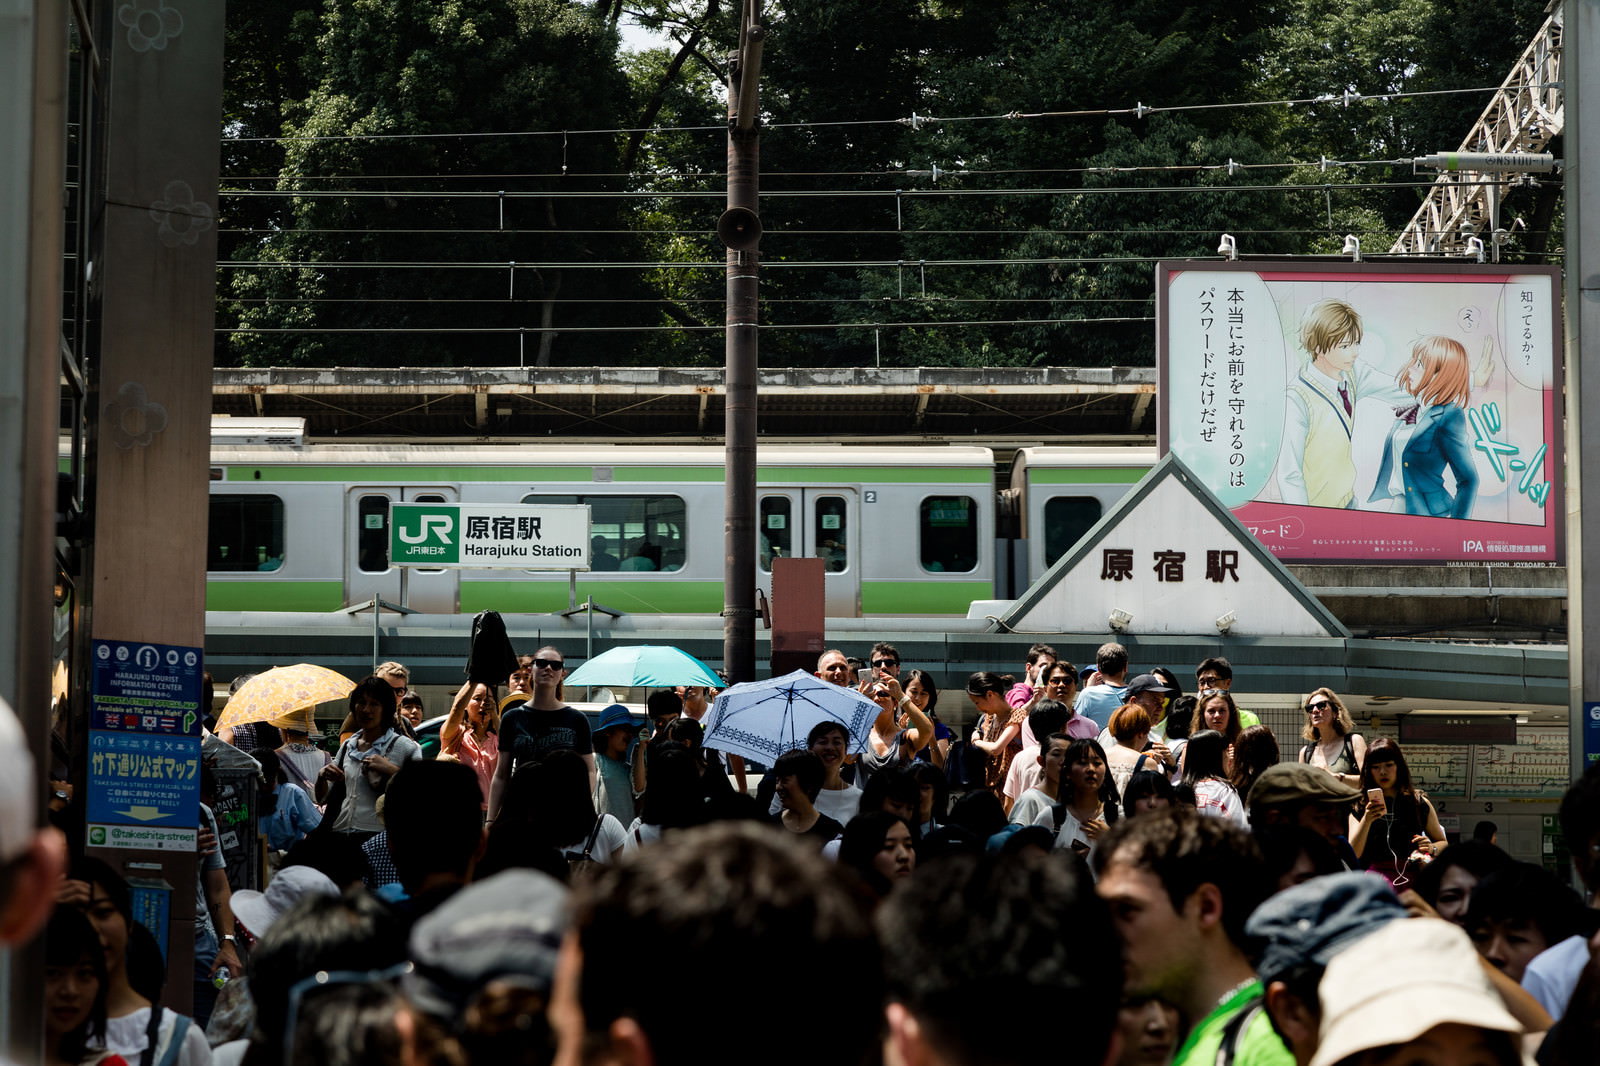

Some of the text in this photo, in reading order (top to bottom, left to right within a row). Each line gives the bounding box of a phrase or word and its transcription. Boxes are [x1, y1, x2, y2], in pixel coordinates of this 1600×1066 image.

[1198, 287, 1217, 443] パスワードだけだぜ
[1227, 287, 1246, 487] 本当にお前を守れるのは
[866, 492, 875, 502] 2
[399, 514, 454, 544] JR
[465, 515, 542, 541] 原宿駅
[405, 546, 446, 555] JR東日本
[465, 544, 582, 558] Harajuku Station
[1463, 540, 1484, 553] IPA
[1101, 548, 1240, 583] 原宿駅
[114, 671, 180, 683] HARAJUKU TOURIST
[110, 679, 183, 691] INFORMATION CENTER
[92, 751, 198, 780] 竹下通り公式マップ
[1438, 801, 1493, 813] 2 3
[111, 828, 195, 841] @takeshita-street
